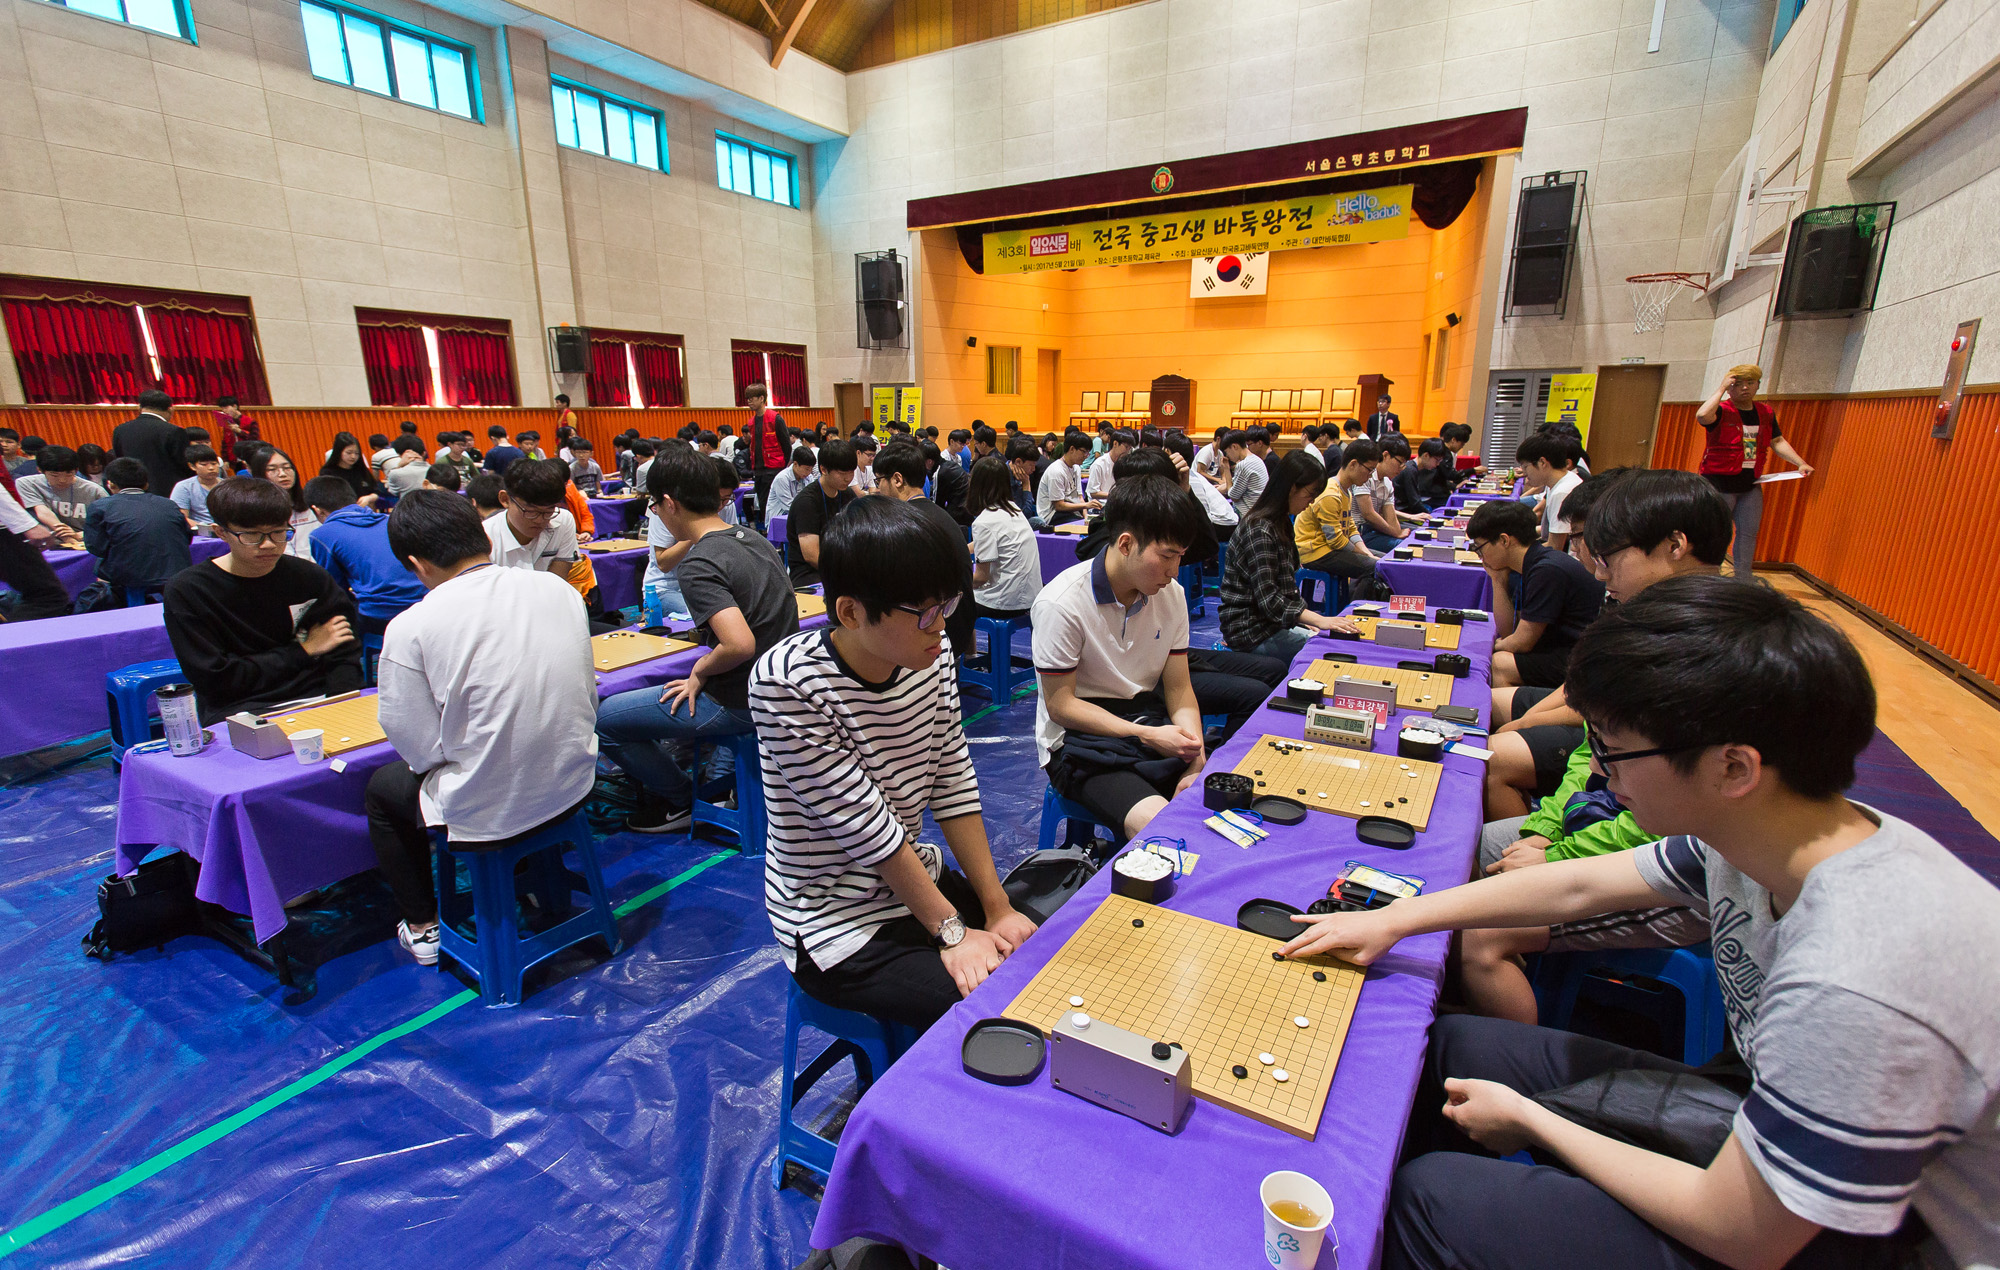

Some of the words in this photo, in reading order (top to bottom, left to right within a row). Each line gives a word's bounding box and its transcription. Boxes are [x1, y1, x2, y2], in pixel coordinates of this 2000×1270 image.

[1305, 144, 1430, 172] 서울은평초등학교
[1336, 193, 1379, 214] Hello
[1365, 204, 1401, 221] baduk
[997, 244, 1027, 258] 제3회
[1031, 234, 1068, 255] 일요신문
[1070, 239, 1082, 251] 배
[1093, 225, 1132, 251] 전국
[1141, 218, 1206, 248] 중고생
[1213, 205, 1314, 237] 바둑왕전
[1336, 697, 1386, 713] 고등최강부
